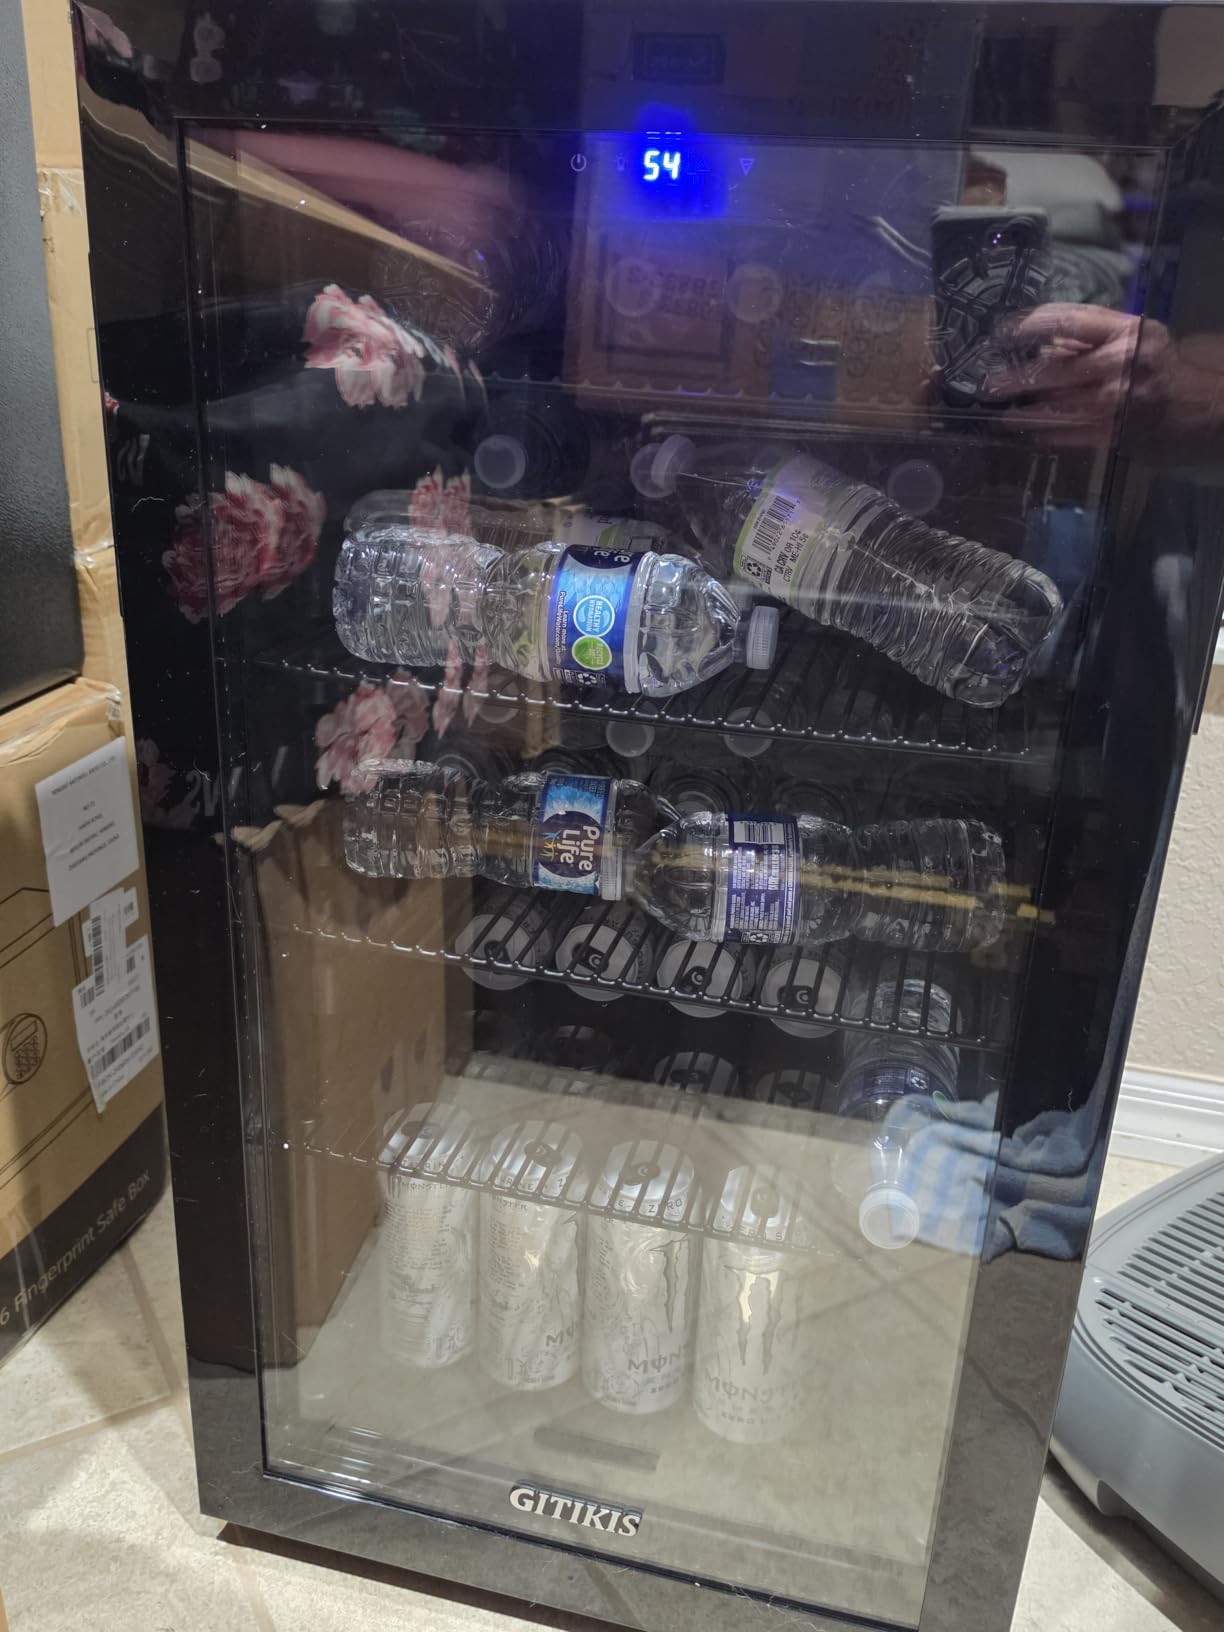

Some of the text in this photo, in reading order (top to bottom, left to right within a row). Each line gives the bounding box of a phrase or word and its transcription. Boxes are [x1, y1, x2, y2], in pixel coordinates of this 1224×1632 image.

[643, 149, 681, 181] 54
[593, 600, 605, 632] HEALTHY
[557, 829, 581, 864] Life
[578, 825, 601, 871] Pure
[14, 1226, 96, 1313] Fingerprint
[96, 1196, 126, 1234] Safe
[127, 1169, 151, 1200] Box
[510, 1488, 640, 1537] GITIKIS
